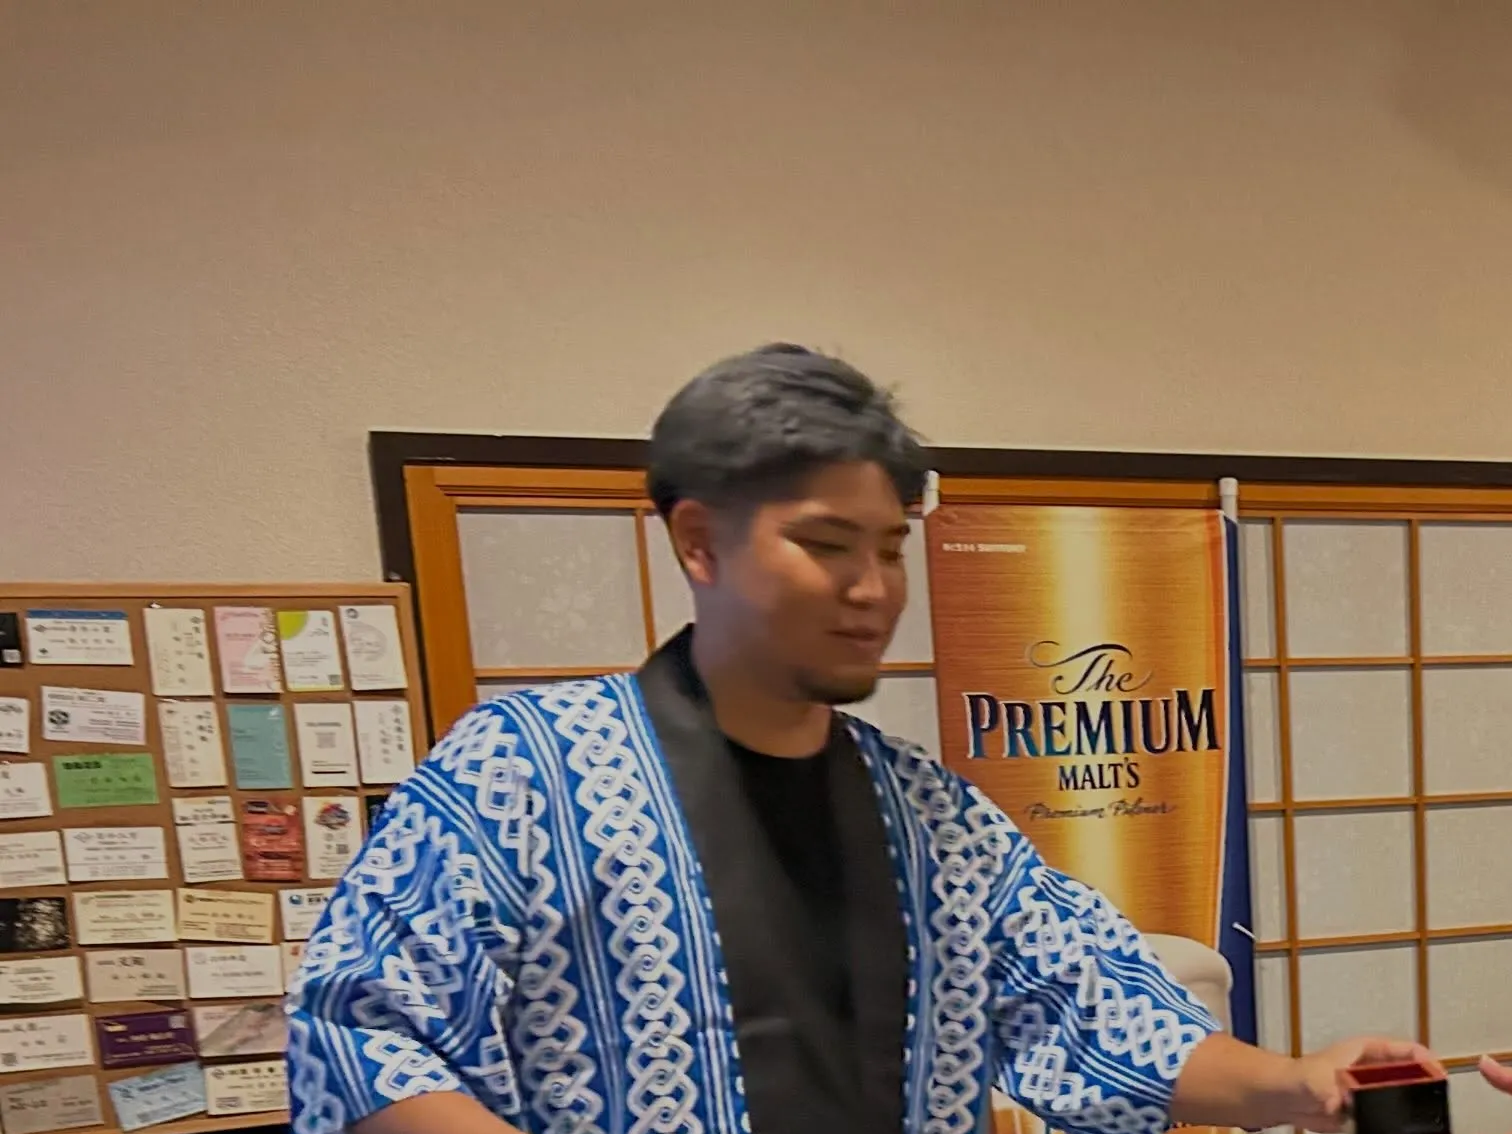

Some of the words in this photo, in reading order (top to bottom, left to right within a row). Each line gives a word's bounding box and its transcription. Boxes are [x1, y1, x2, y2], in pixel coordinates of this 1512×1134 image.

[1028, 640, 1154, 695] The
[962, 687, 1221, 760] PREMIUM
[1058, 757, 1140, 791] MALT'S
[1025, 802, 1105, 821] Premium
